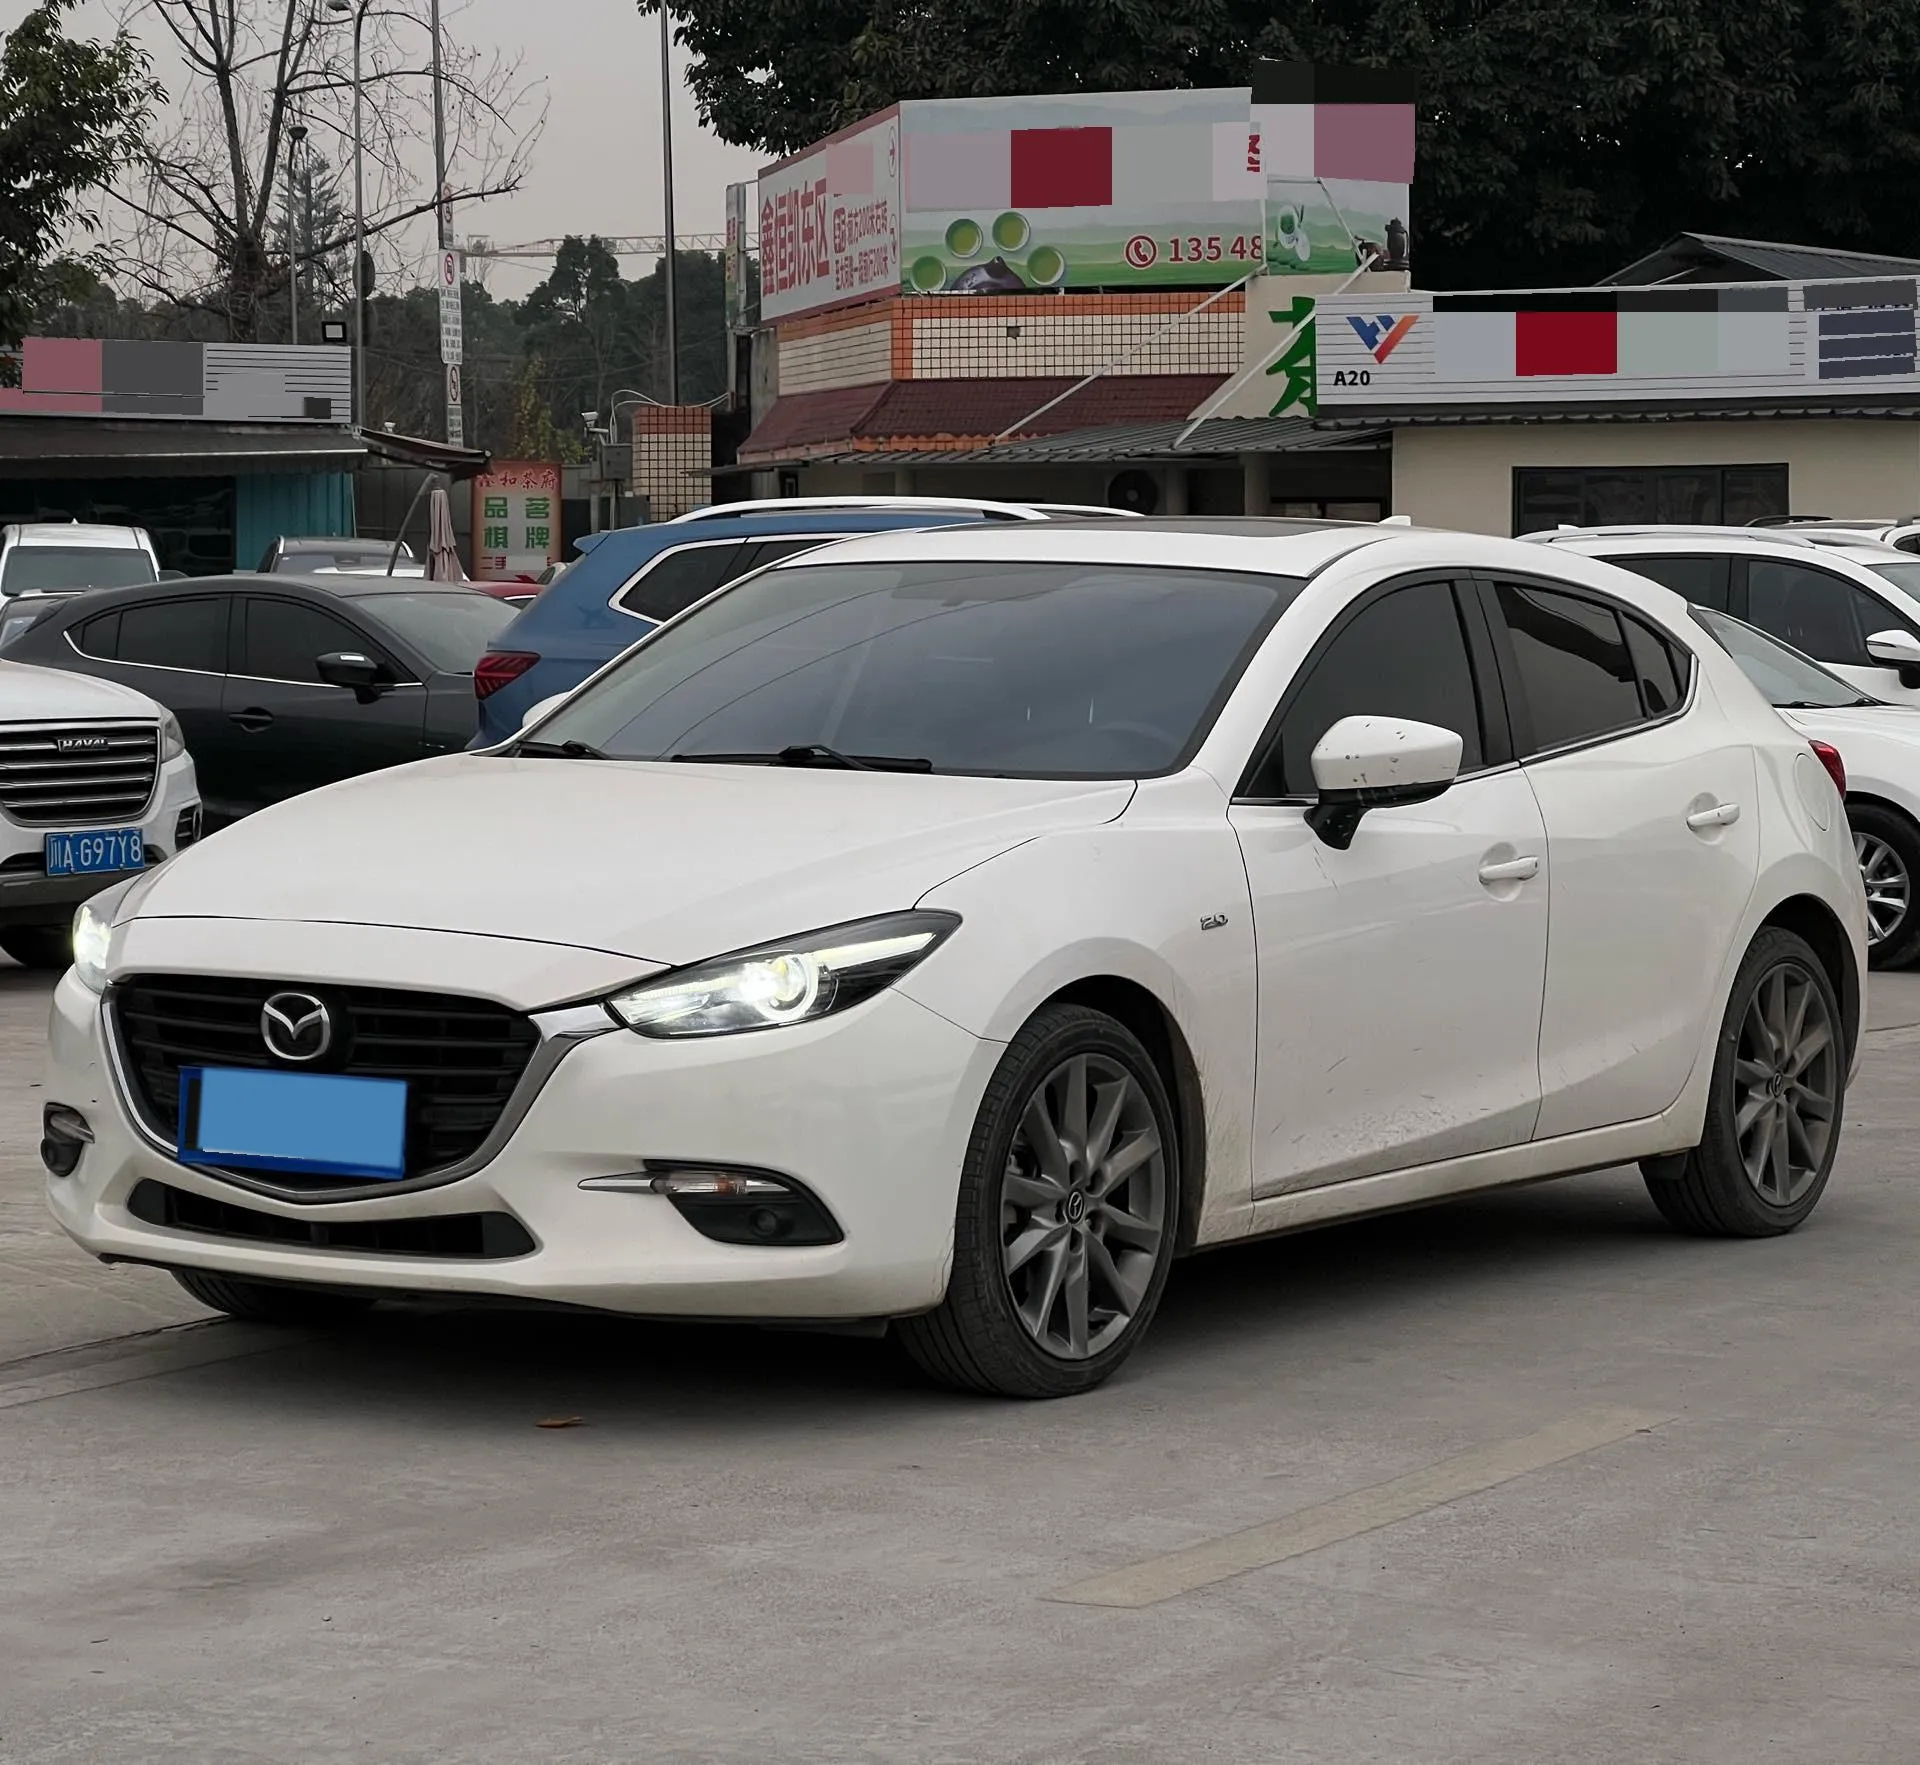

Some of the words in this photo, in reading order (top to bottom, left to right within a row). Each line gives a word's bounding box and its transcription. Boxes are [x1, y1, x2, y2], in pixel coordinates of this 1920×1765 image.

[1333, 370, 1371, 386] A20
[484, 496, 550, 518] 品茗
[484, 526, 550, 549] 棋牌
